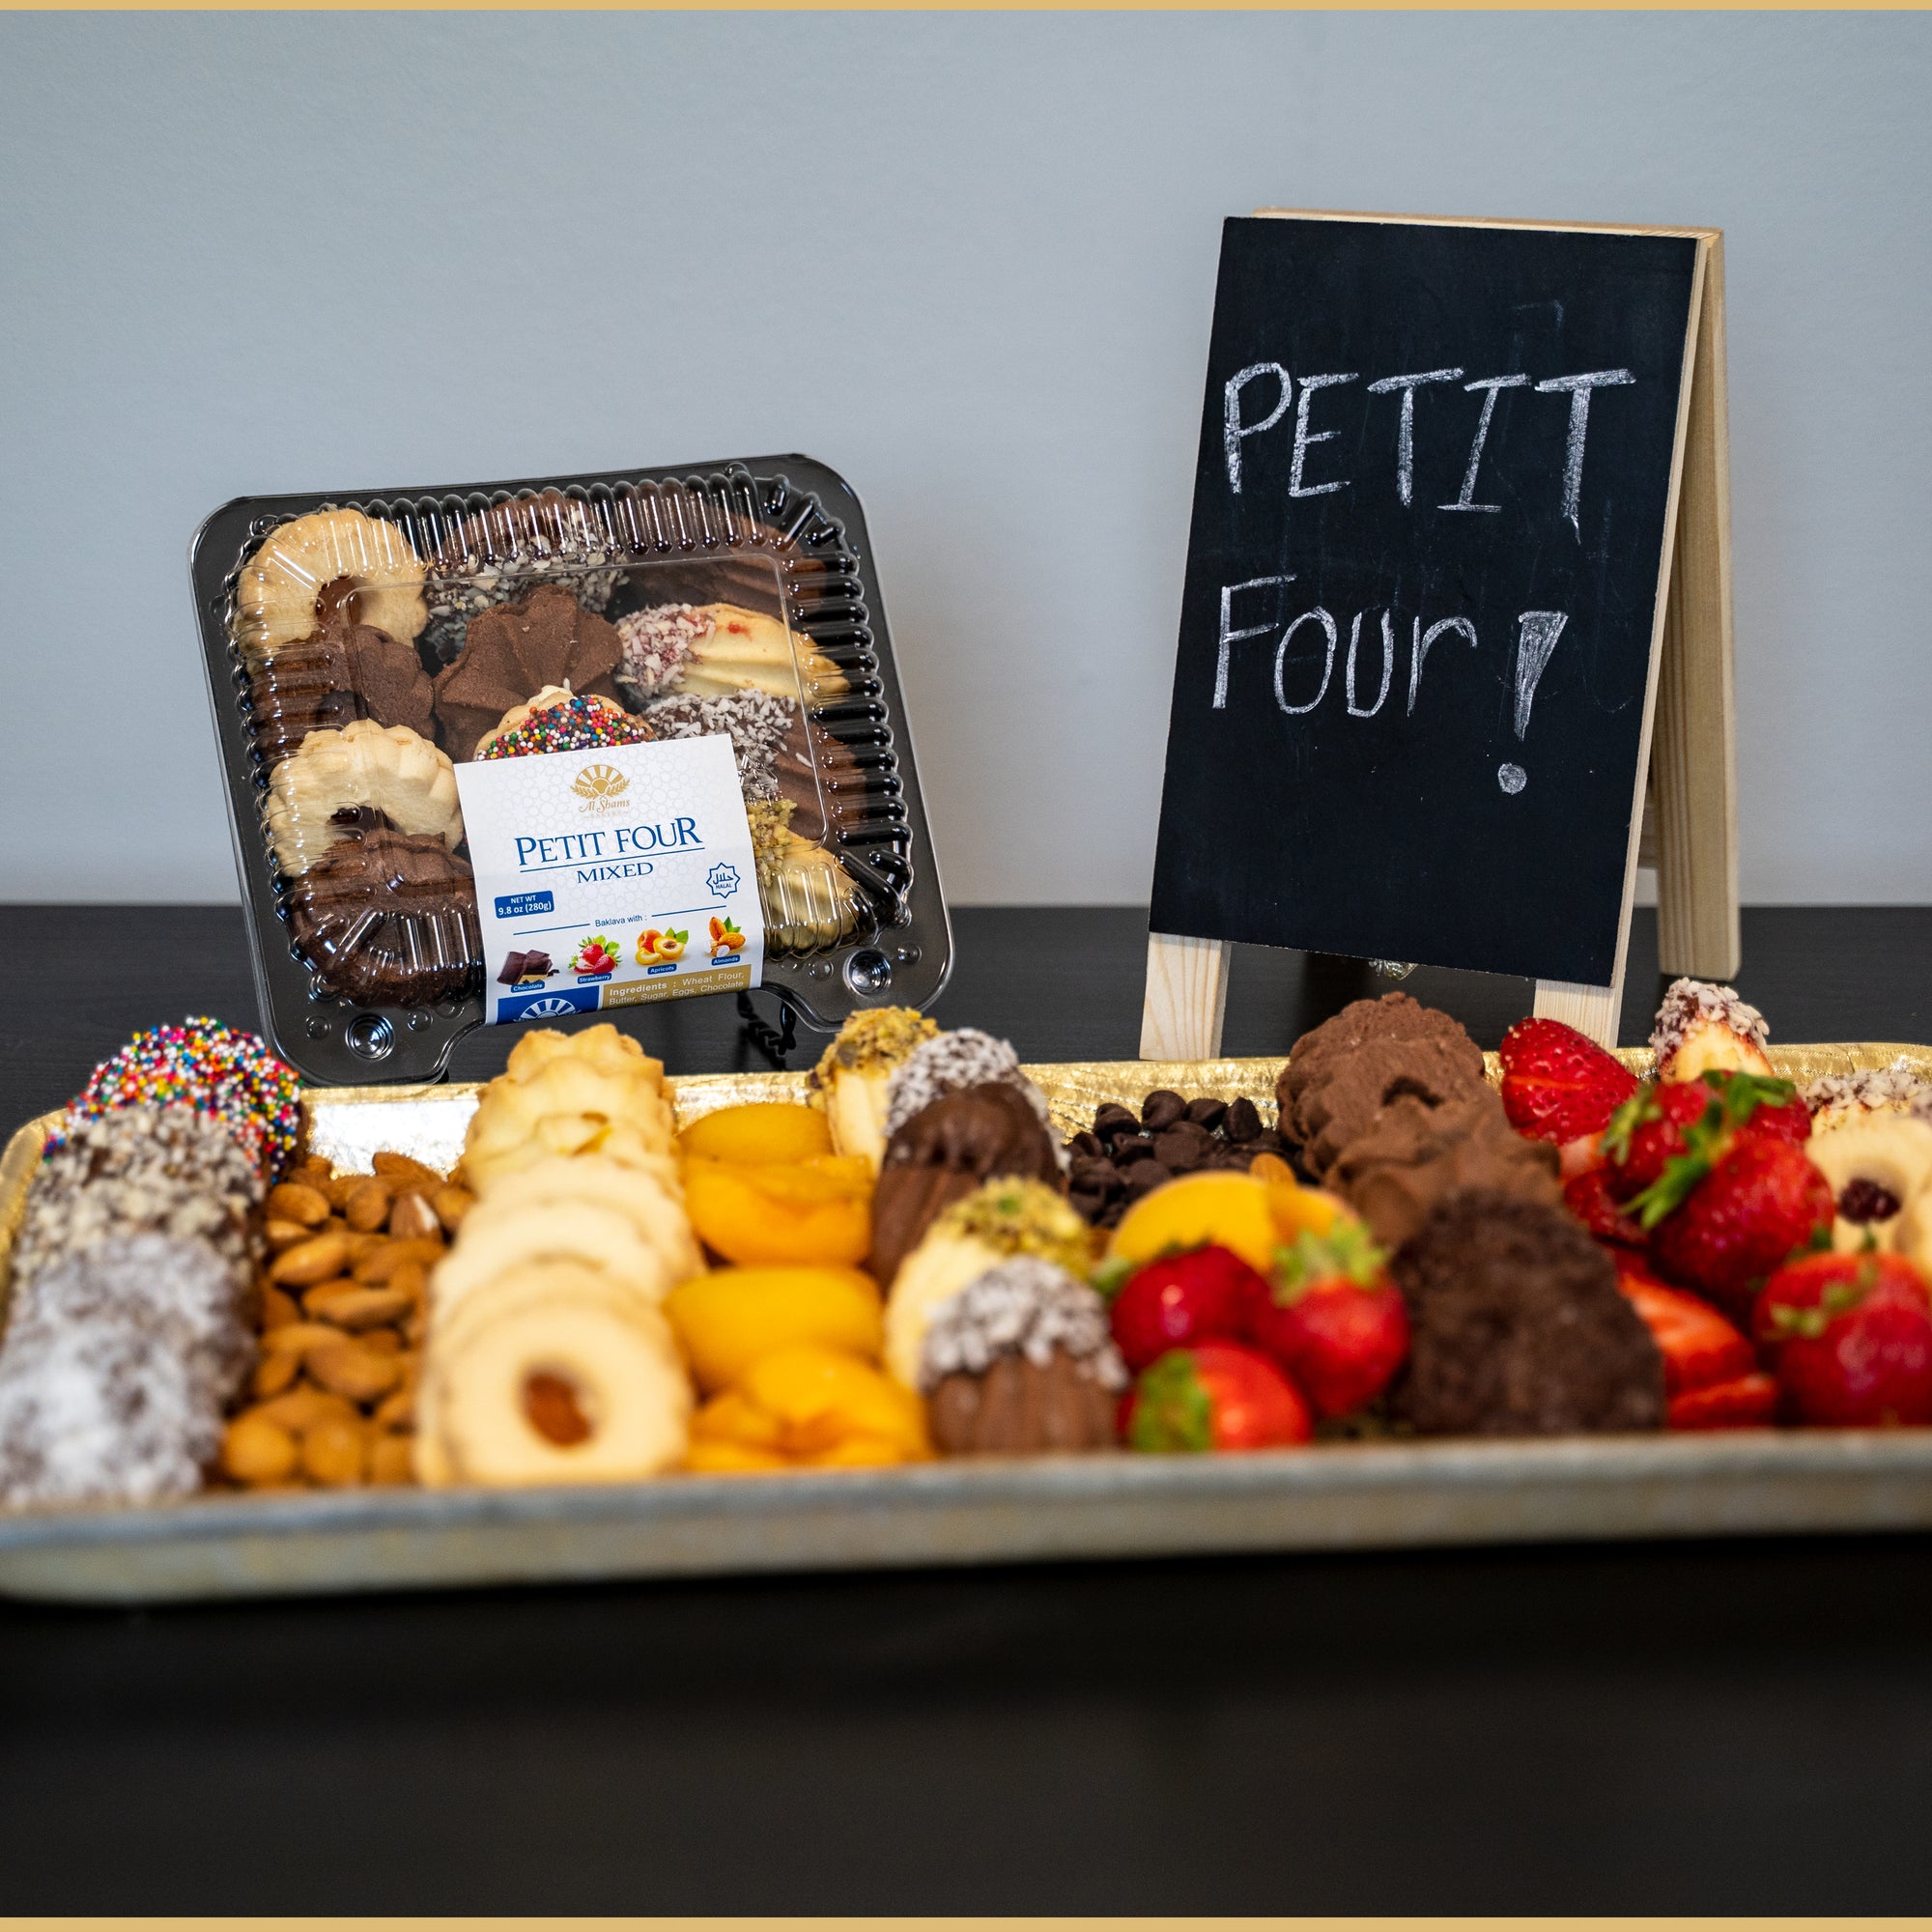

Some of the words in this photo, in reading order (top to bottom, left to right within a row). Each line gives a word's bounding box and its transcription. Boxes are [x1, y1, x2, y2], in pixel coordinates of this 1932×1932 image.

[1223, 361, 1636, 544] PETIT
[596, 795, 631, 812] Shams
[514, 832, 606, 867] PETIT
[614, 816, 703, 853] FOUR
[577, 862, 654, 884] MIXED
[712, 872, 734, 885] حلال
[497, 906, 512, 916] 9.8
[525, 900, 552, 914] (280g)
[595, 918, 626, 927] Baklava
[627, 915, 643, 923] with
[713, 956, 739, 965] Almonds
[649, 965, 675, 975] Apricots
[579, 974, 611, 984] Strawberry
[610, 981, 667, 996] Ingredients
[682, 976, 713, 987] Wheat
[700, 979, 745, 993] Chocolate
[513, 982, 543, 992] Chocolate
